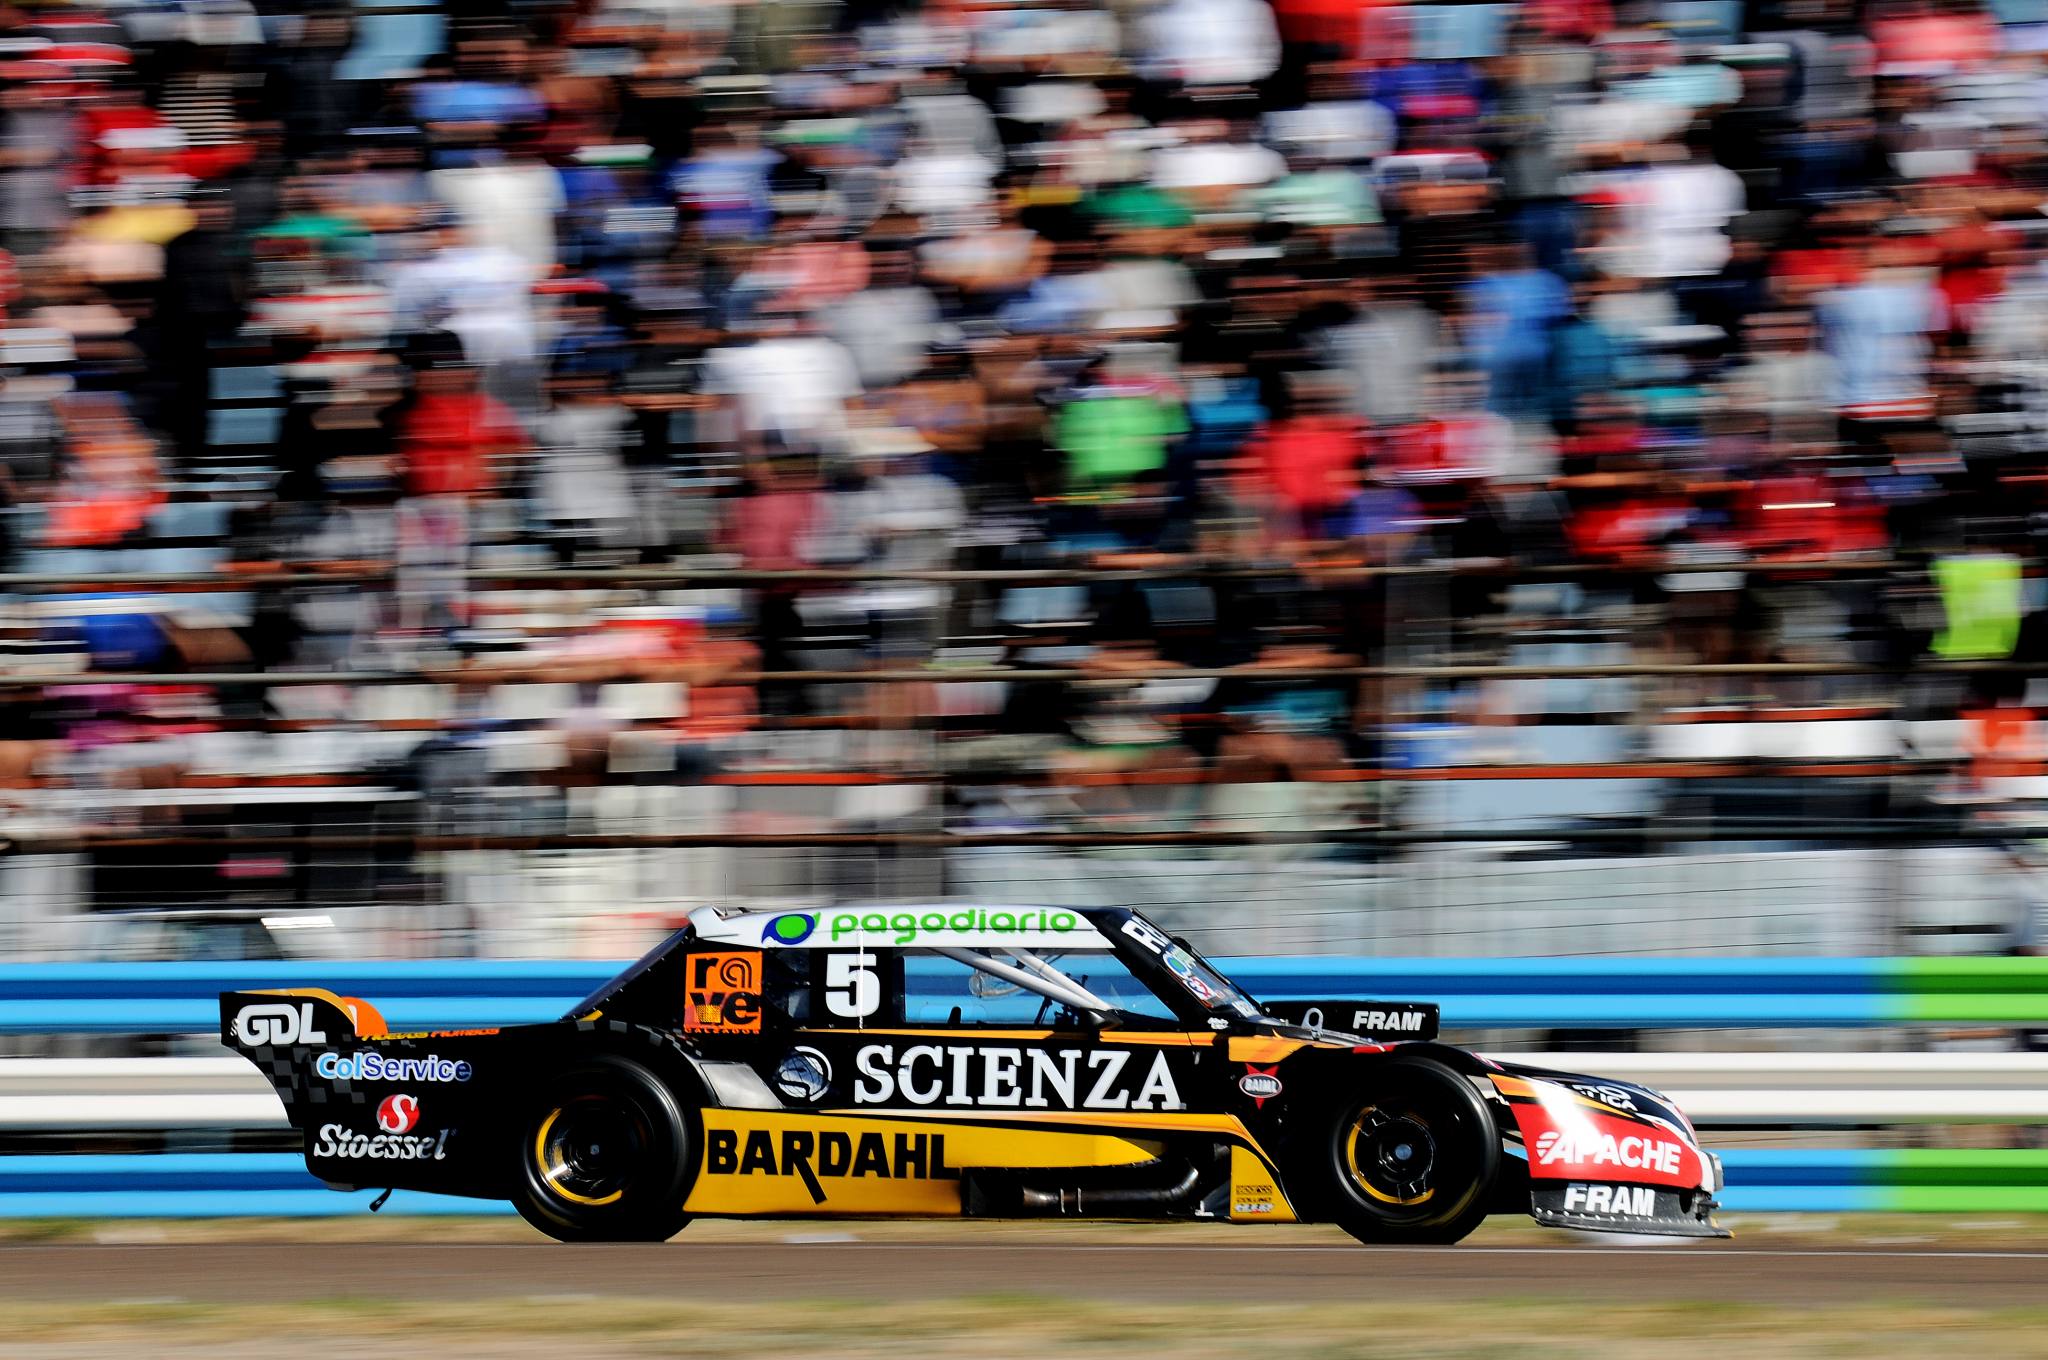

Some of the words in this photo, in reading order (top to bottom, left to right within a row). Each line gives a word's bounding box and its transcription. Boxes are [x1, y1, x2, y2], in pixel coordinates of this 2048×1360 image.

[831, 908, 1077, 944] pagodiario
[825, 953, 880, 1017] 5
[236, 1002, 326, 1046] GDL
[1352, 1010, 1422, 1031] FRAM
[316, 1052, 472, 1082] ColService
[853, 1044, 1187, 1111] SCIENZA
[313, 1123, 451, 1161] Stoessel
[1536, 1131, 1681, 1175] APACHE
[707, 1129, 963, 1205] BARDAHL
[1564, 1182, 1656, 1217] FRAM
